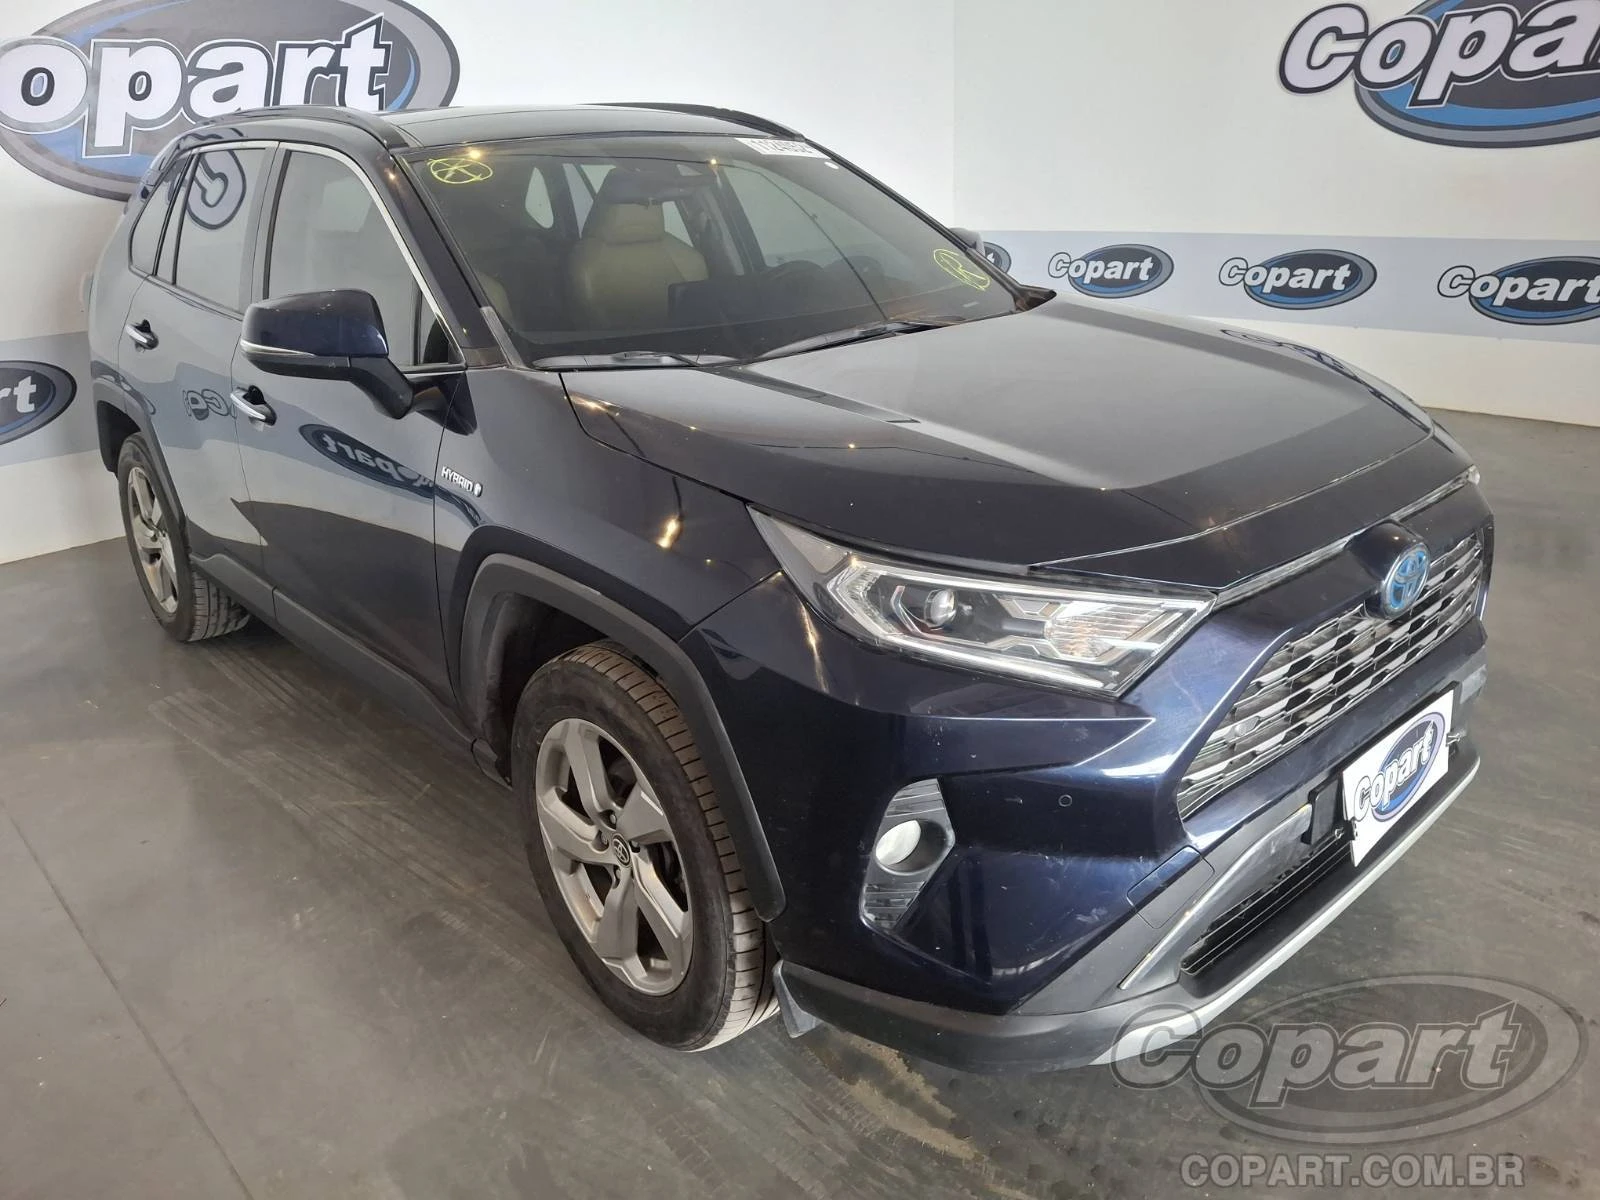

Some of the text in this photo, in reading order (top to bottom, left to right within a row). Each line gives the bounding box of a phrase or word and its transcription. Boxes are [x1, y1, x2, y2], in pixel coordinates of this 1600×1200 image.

[1048, 252, 1154, 284] Copart
[1219, 256, 1352, 294] Copart
[1437, 264, 1600, 306] Copart
[441, 466, 474, 493] HYBRID
[1354, 719, 1435, 822] Copart
